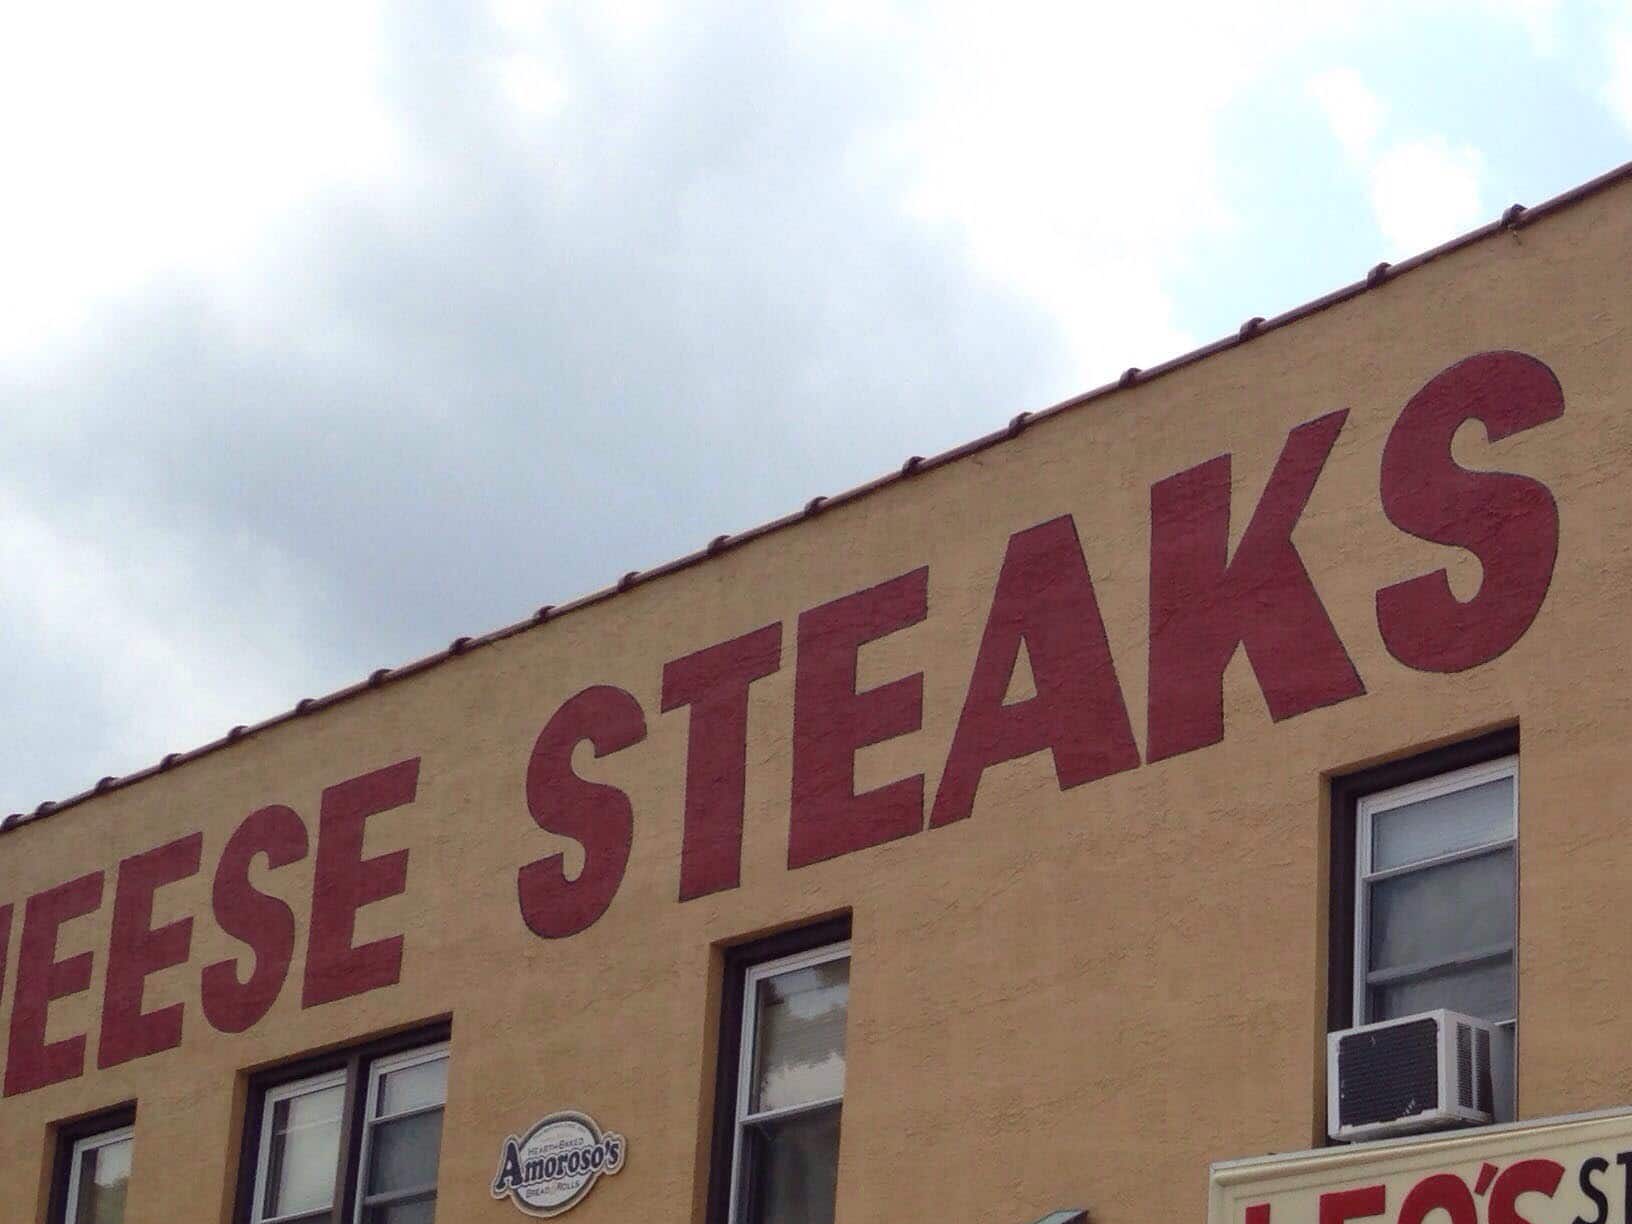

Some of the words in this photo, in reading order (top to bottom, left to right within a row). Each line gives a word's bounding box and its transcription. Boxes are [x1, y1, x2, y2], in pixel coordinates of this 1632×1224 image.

[0, 756, 421, 1097] EESE
[518, 350, 1565, 939] STEAKS
[495, 1140, 620, 1190] Amoroso's
